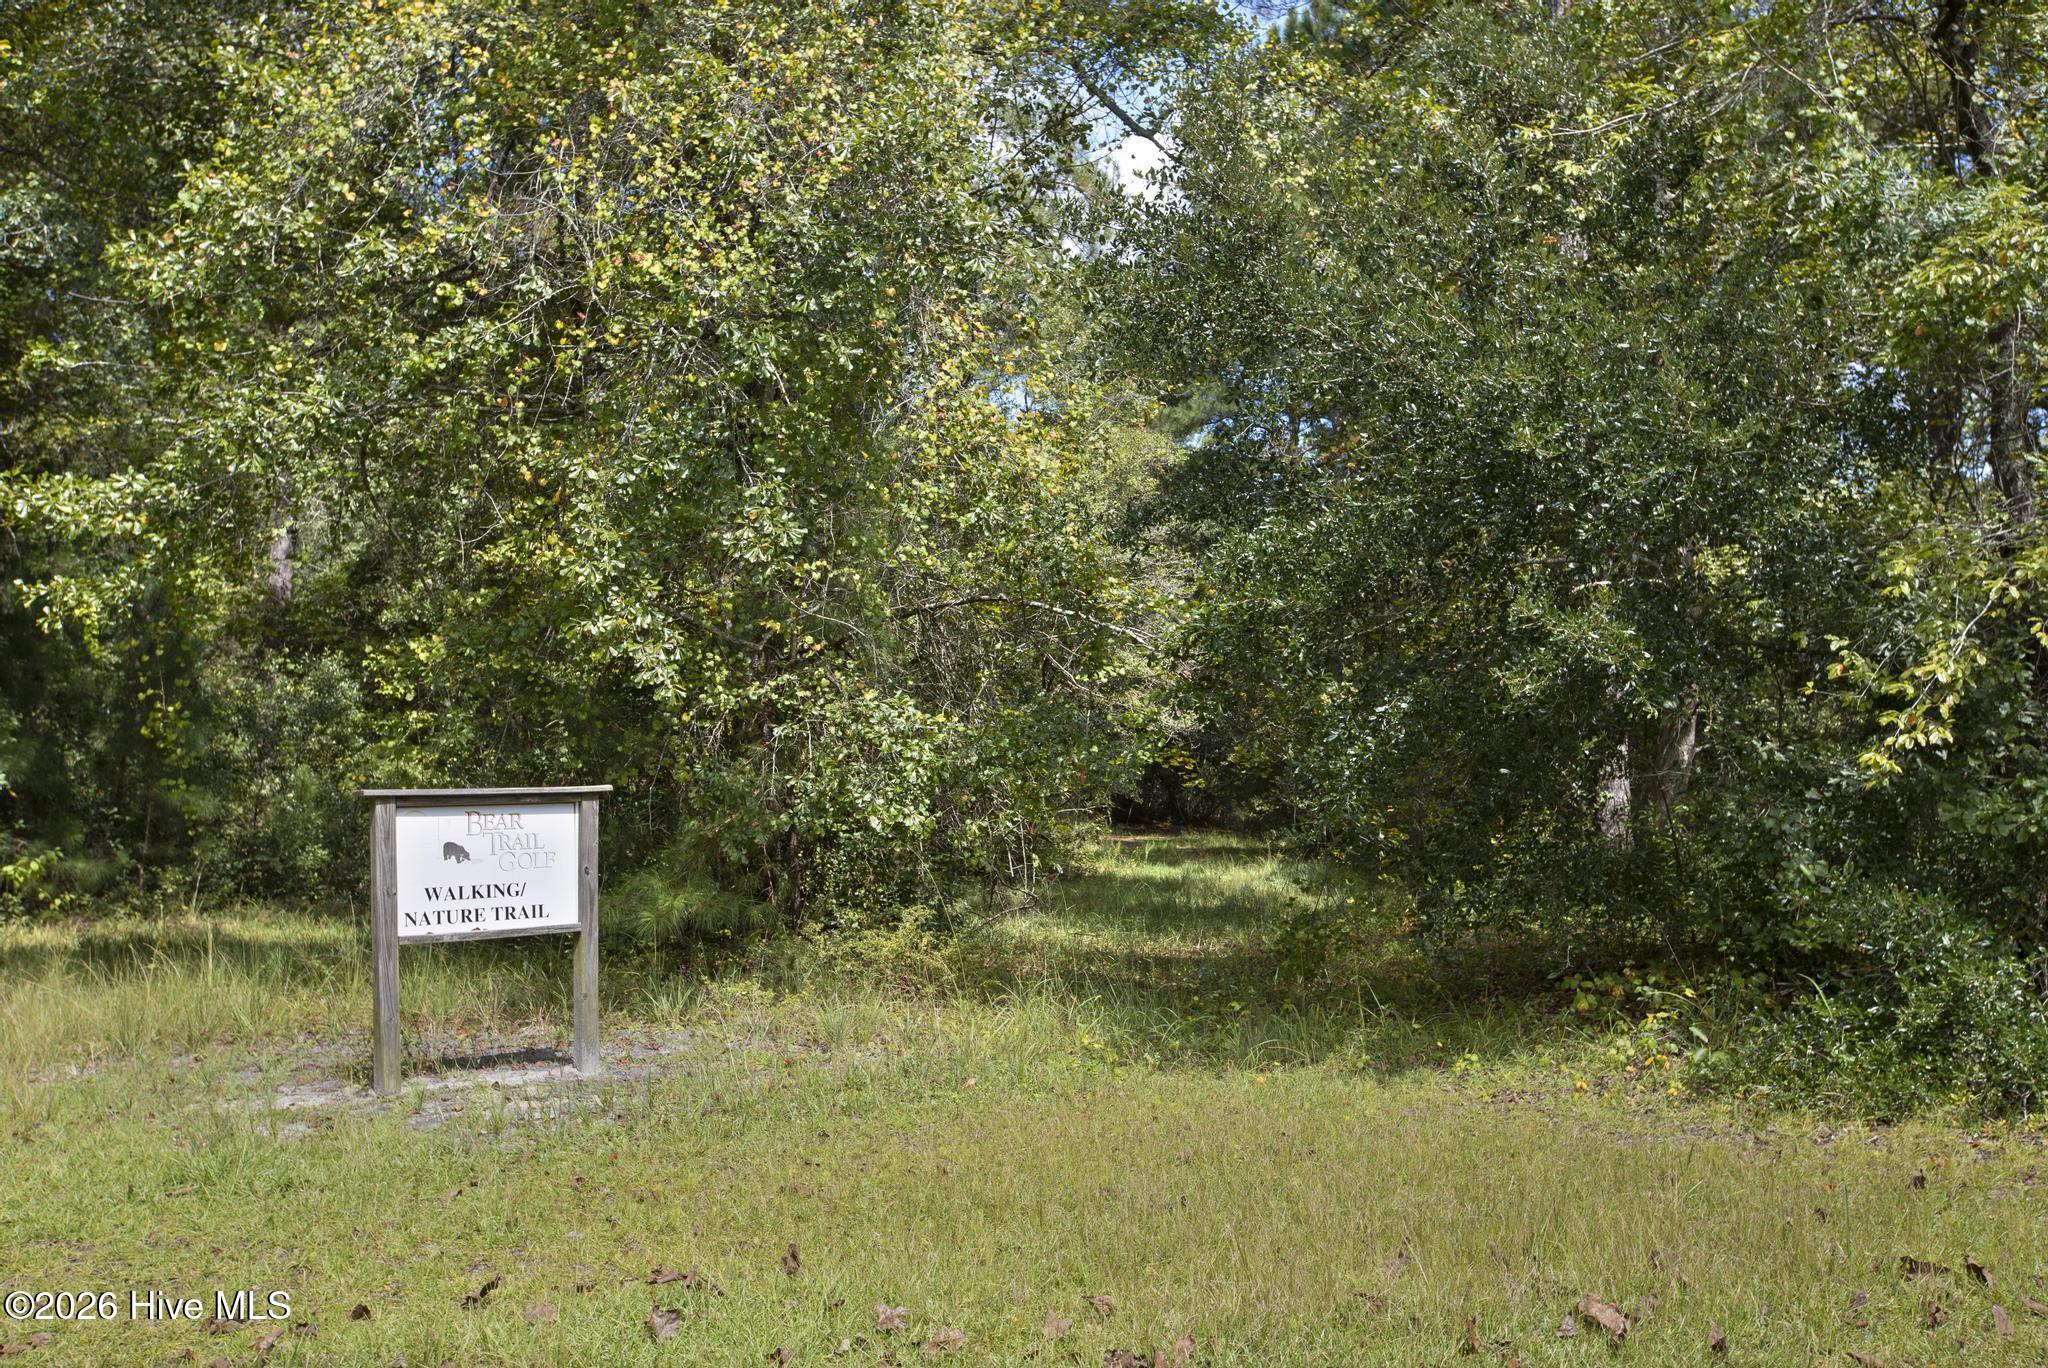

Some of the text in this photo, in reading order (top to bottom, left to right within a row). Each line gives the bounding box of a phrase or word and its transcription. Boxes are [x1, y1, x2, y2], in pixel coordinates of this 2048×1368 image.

[465, 811, 525, 837] BEAR
[483, 832, 545, 856] TRAIL
[498, 851, 557, 872] GOLF
[425, 882, 527, 902] WALKING/
[404, 904, 550, 927] NATURE TRAIL
